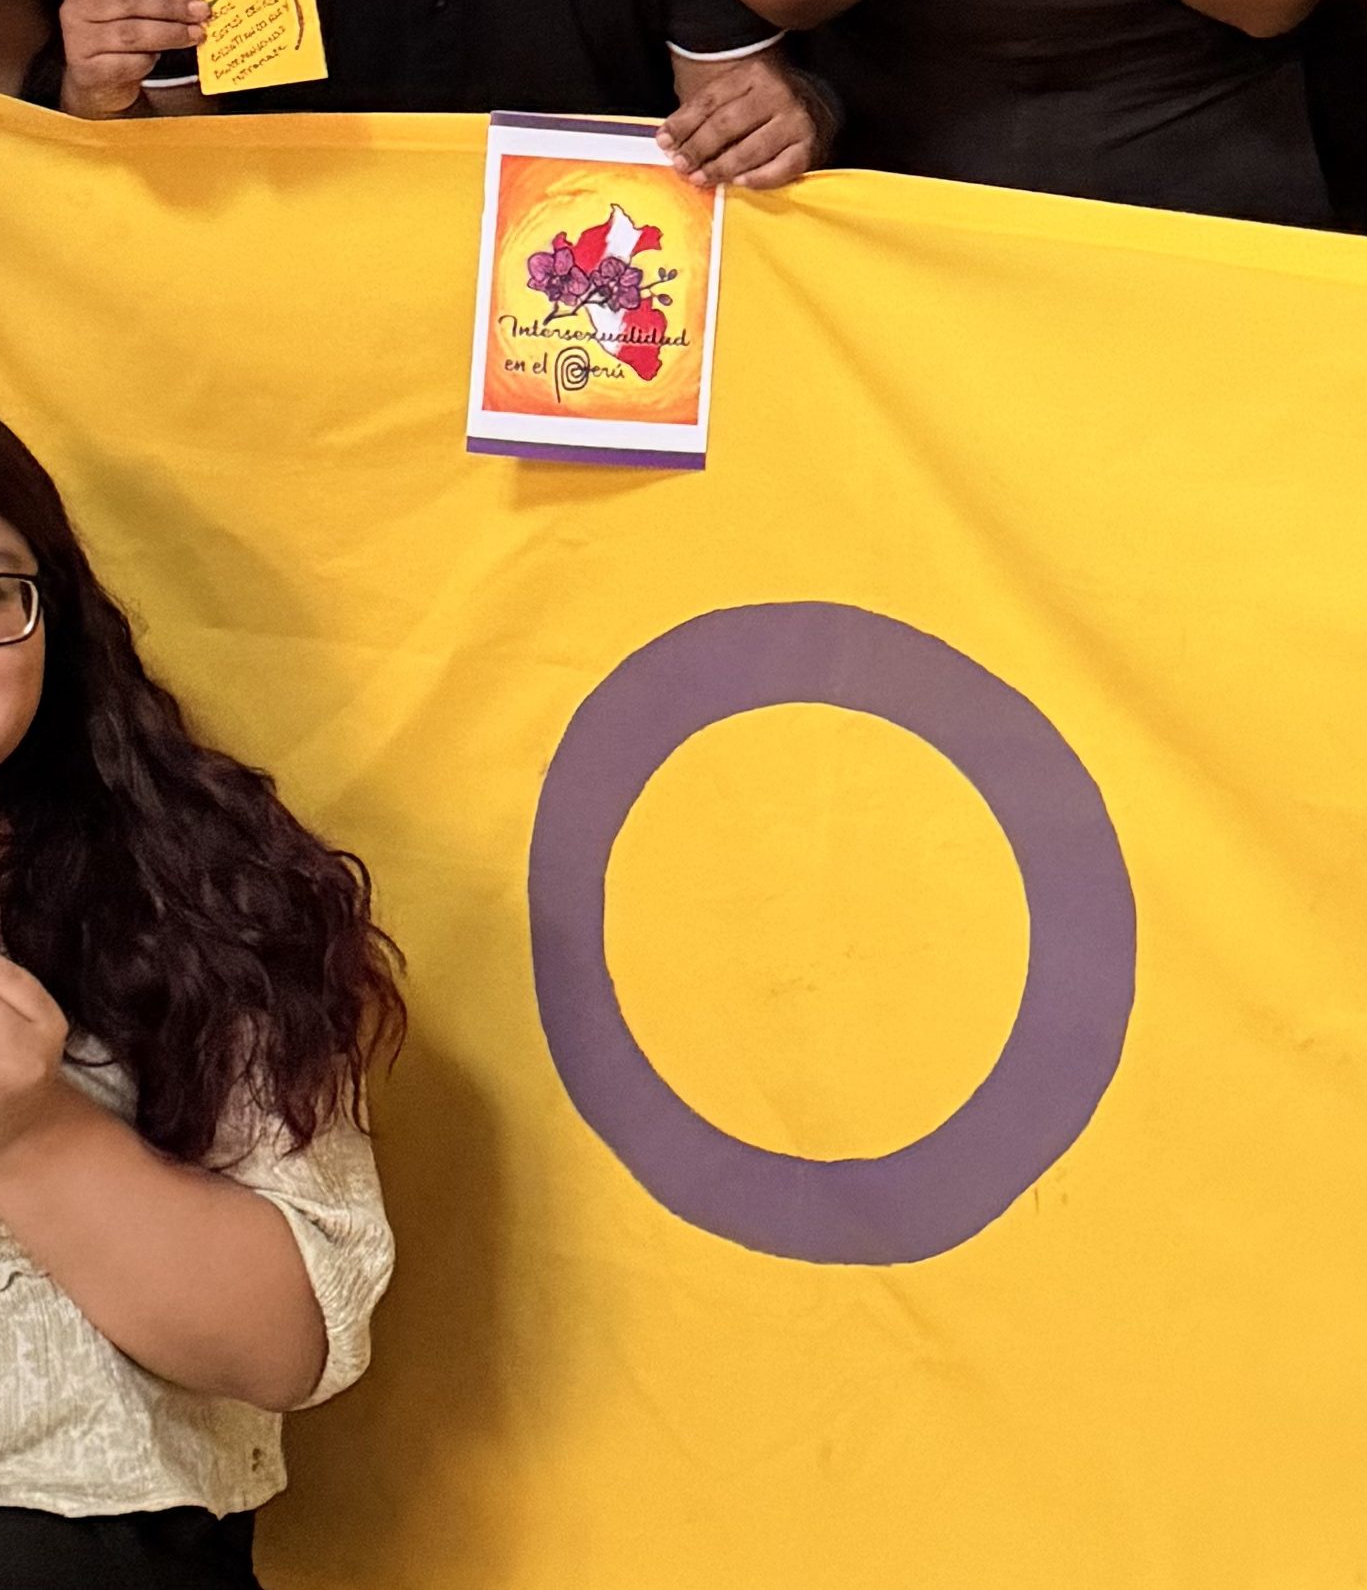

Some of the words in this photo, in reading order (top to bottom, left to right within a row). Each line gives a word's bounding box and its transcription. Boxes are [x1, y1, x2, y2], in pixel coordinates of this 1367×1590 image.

[498, 315, 691, 348] Intersexualidad
[504, 359, 526, 373] en
[532, 352, 548, 374] el
[554, 346, 625, 403] Perú
